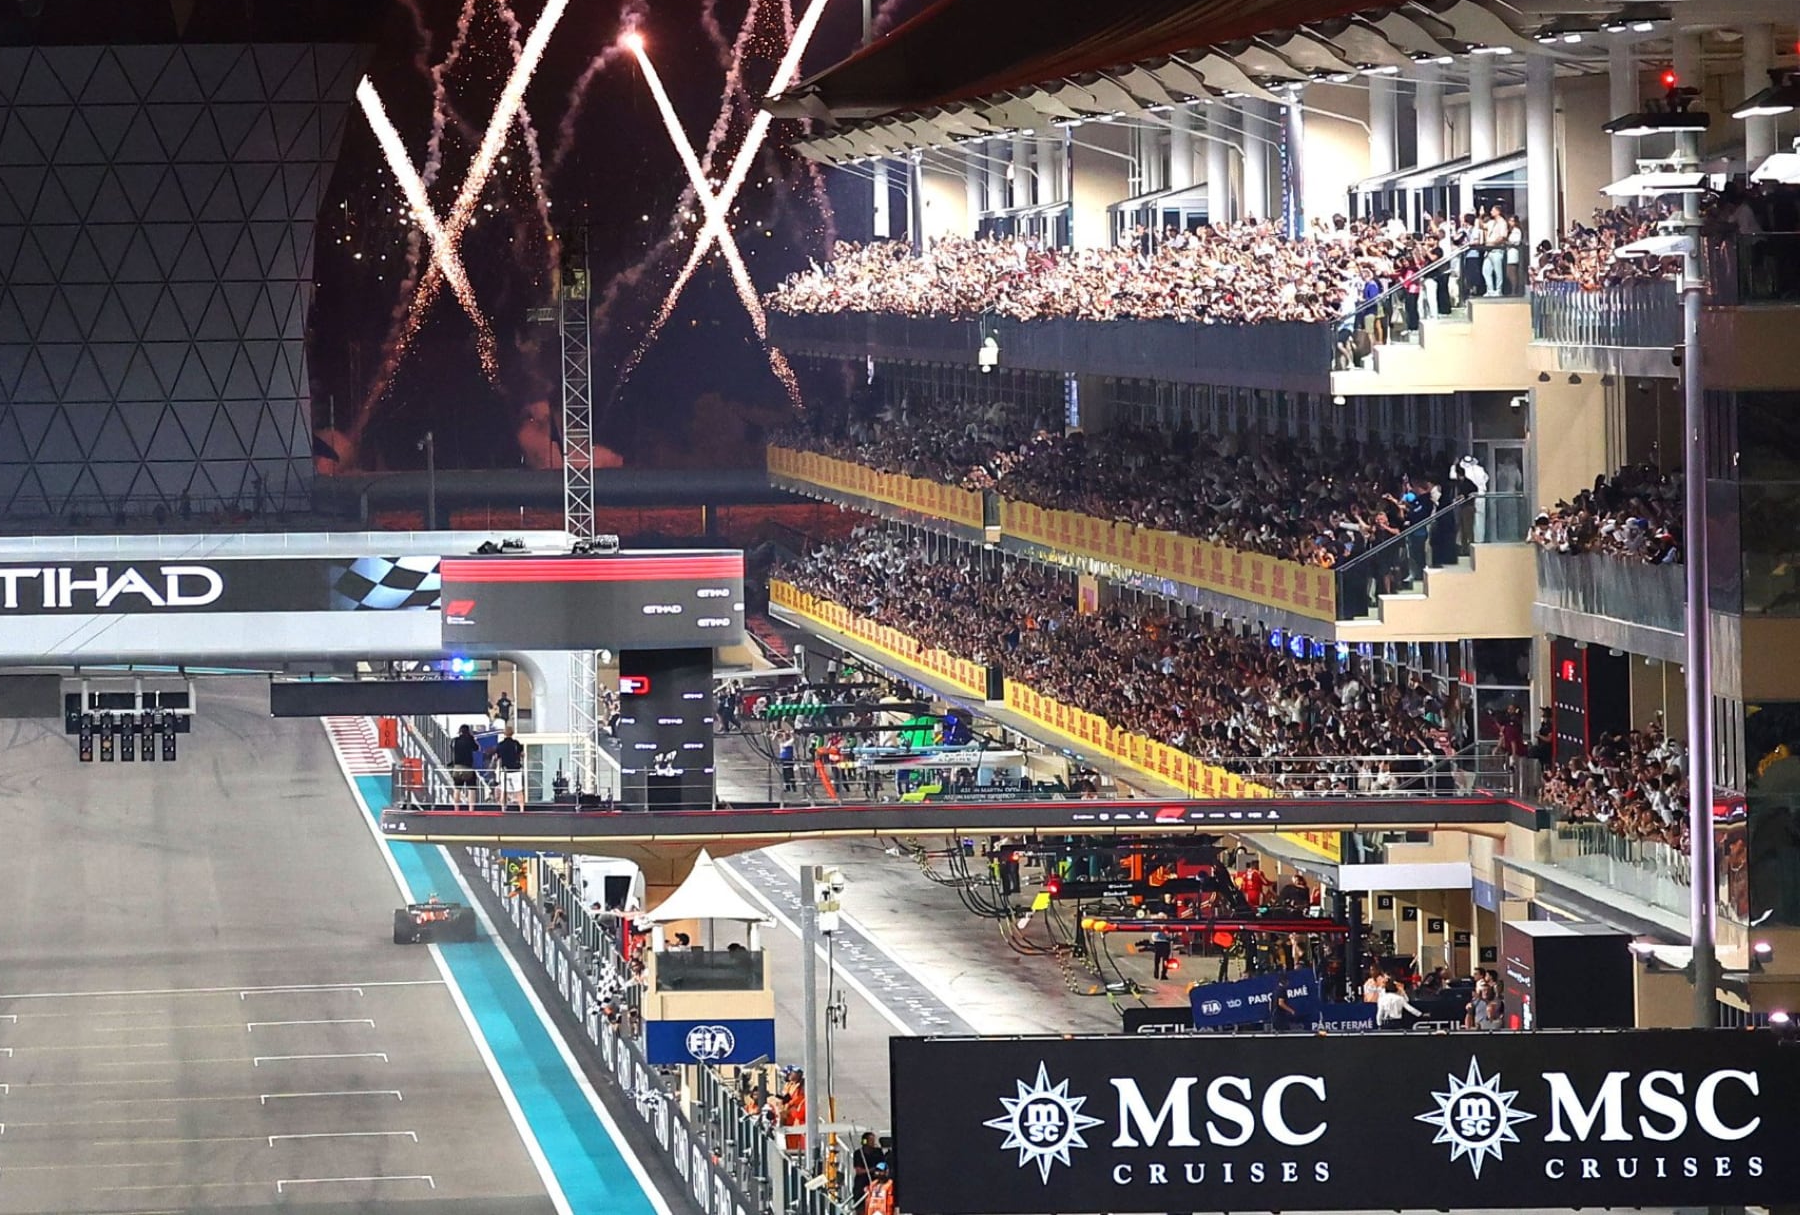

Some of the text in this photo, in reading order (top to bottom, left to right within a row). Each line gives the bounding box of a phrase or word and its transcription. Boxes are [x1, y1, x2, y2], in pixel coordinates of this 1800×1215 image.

[1382, 898, 1389, 906] 8
[1432, 921, 1440, 930] 6
[1202, 1002, 1220, 1014] FIA
[1312, 1018, 1373, 1031] PARC FERMÉ
[690, 1032, 731, 1053] FIA
[1109, 1074, 1327, 1148] MSC
[1541, 1069, 1761, 1142] MSC
[1112, 1161, 1330, 1184] CRUISES
[1544, 1156, 1763, 1179] CRUISES
